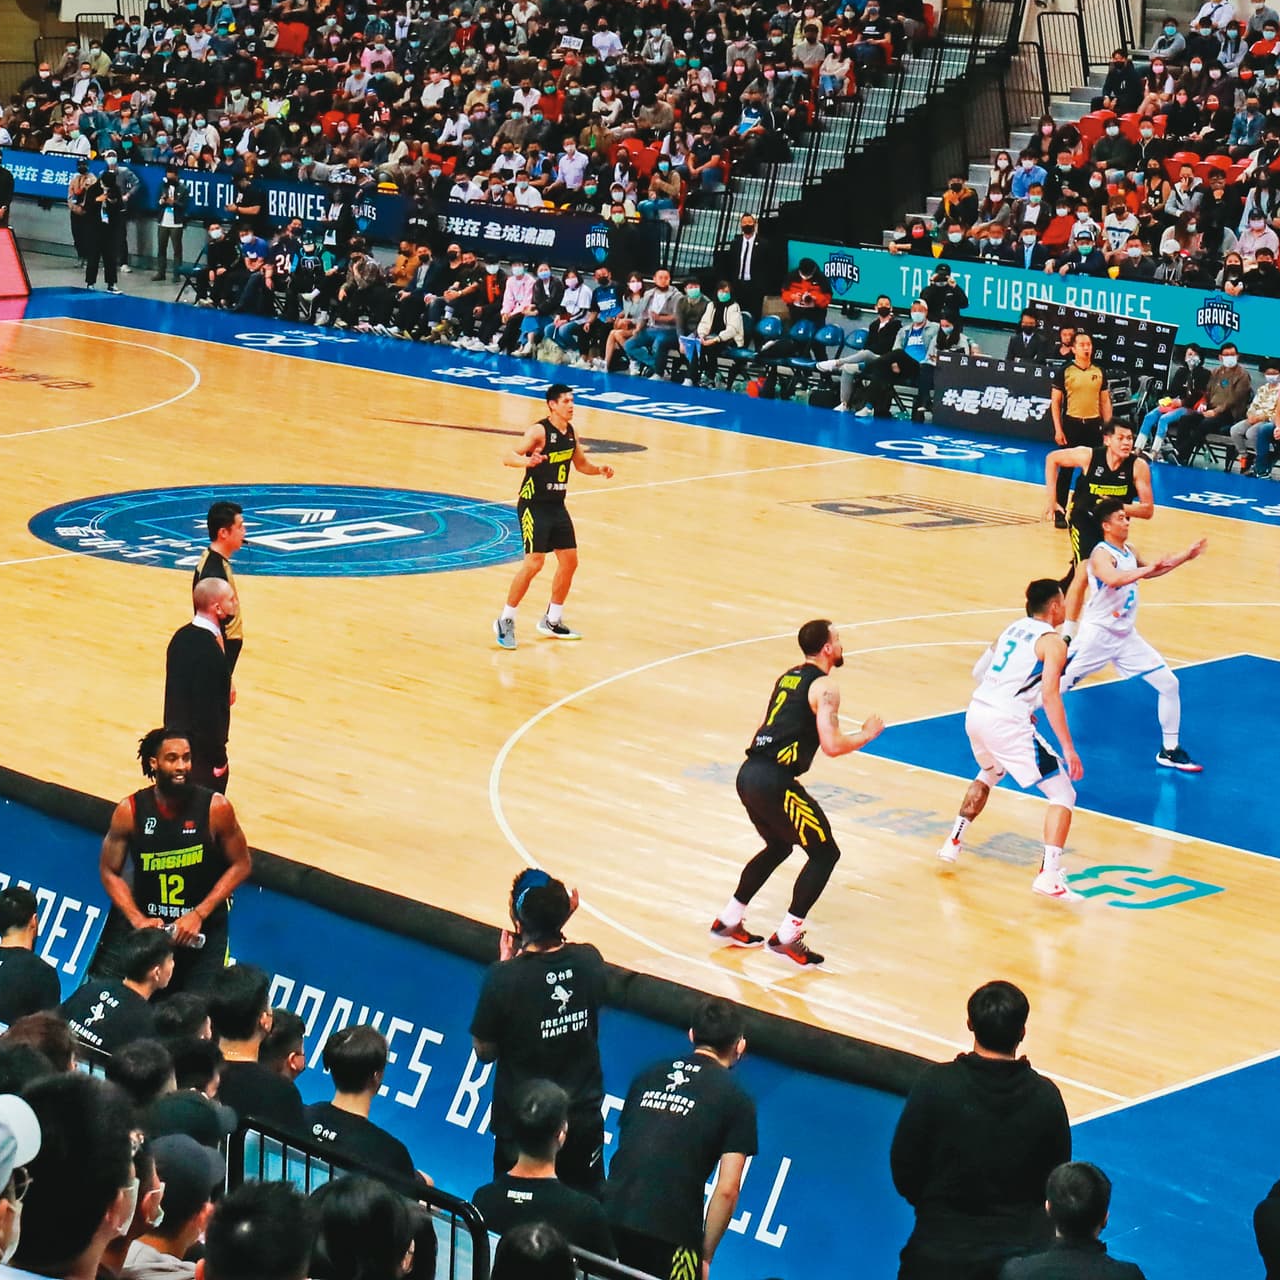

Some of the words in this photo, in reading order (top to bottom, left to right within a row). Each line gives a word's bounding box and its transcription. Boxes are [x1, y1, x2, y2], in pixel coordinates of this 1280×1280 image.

[268, 189, 326, 222] BRAVES
[824, 261, 860, 283] BRAVES
[1196, 308, 1240, 333] BRAVES
[557, 464, 567, 483] 6
[991, 639, 1017, 673] 3
[158, 873, 186, 906] 12
